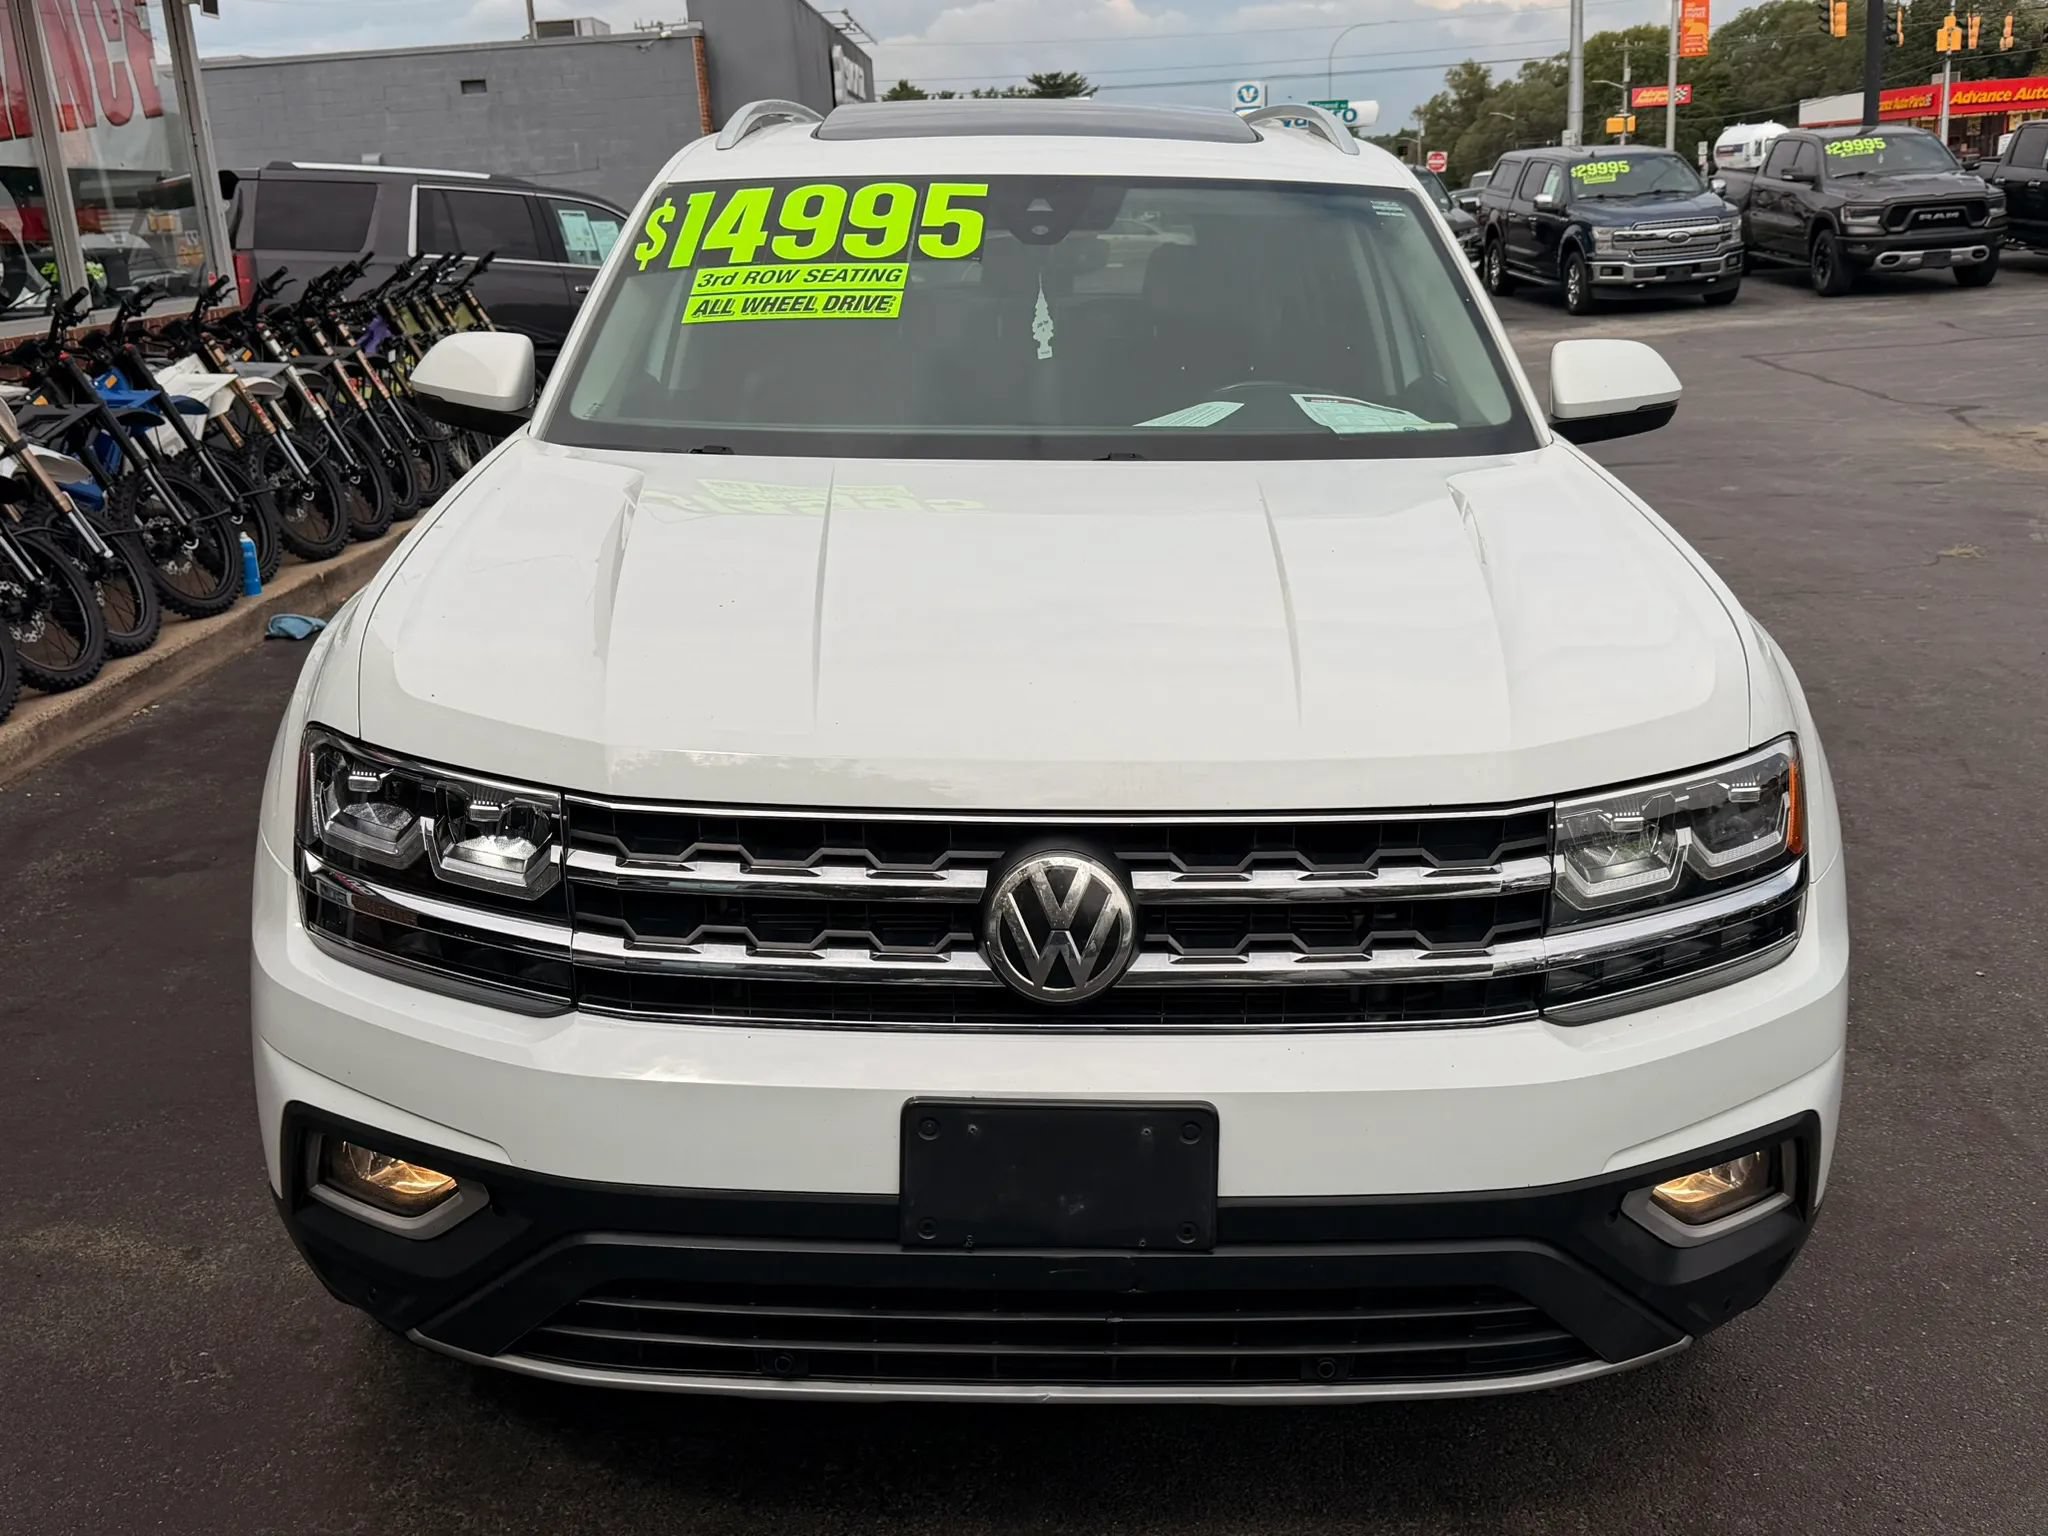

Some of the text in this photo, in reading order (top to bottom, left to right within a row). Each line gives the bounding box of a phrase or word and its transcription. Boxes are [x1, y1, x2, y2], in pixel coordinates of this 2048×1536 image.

[1950, 90, 2012, 105] Advance
[1823, 137, 1887, 155] $29995
[1570, 160, 1631, 178] $29995
[634, 182, 989, 271] $14995
[697, 267, 903, 288] 3rd ROW SEATING
[692, 295, 894, 317] ALL WHEEL DRIVE
